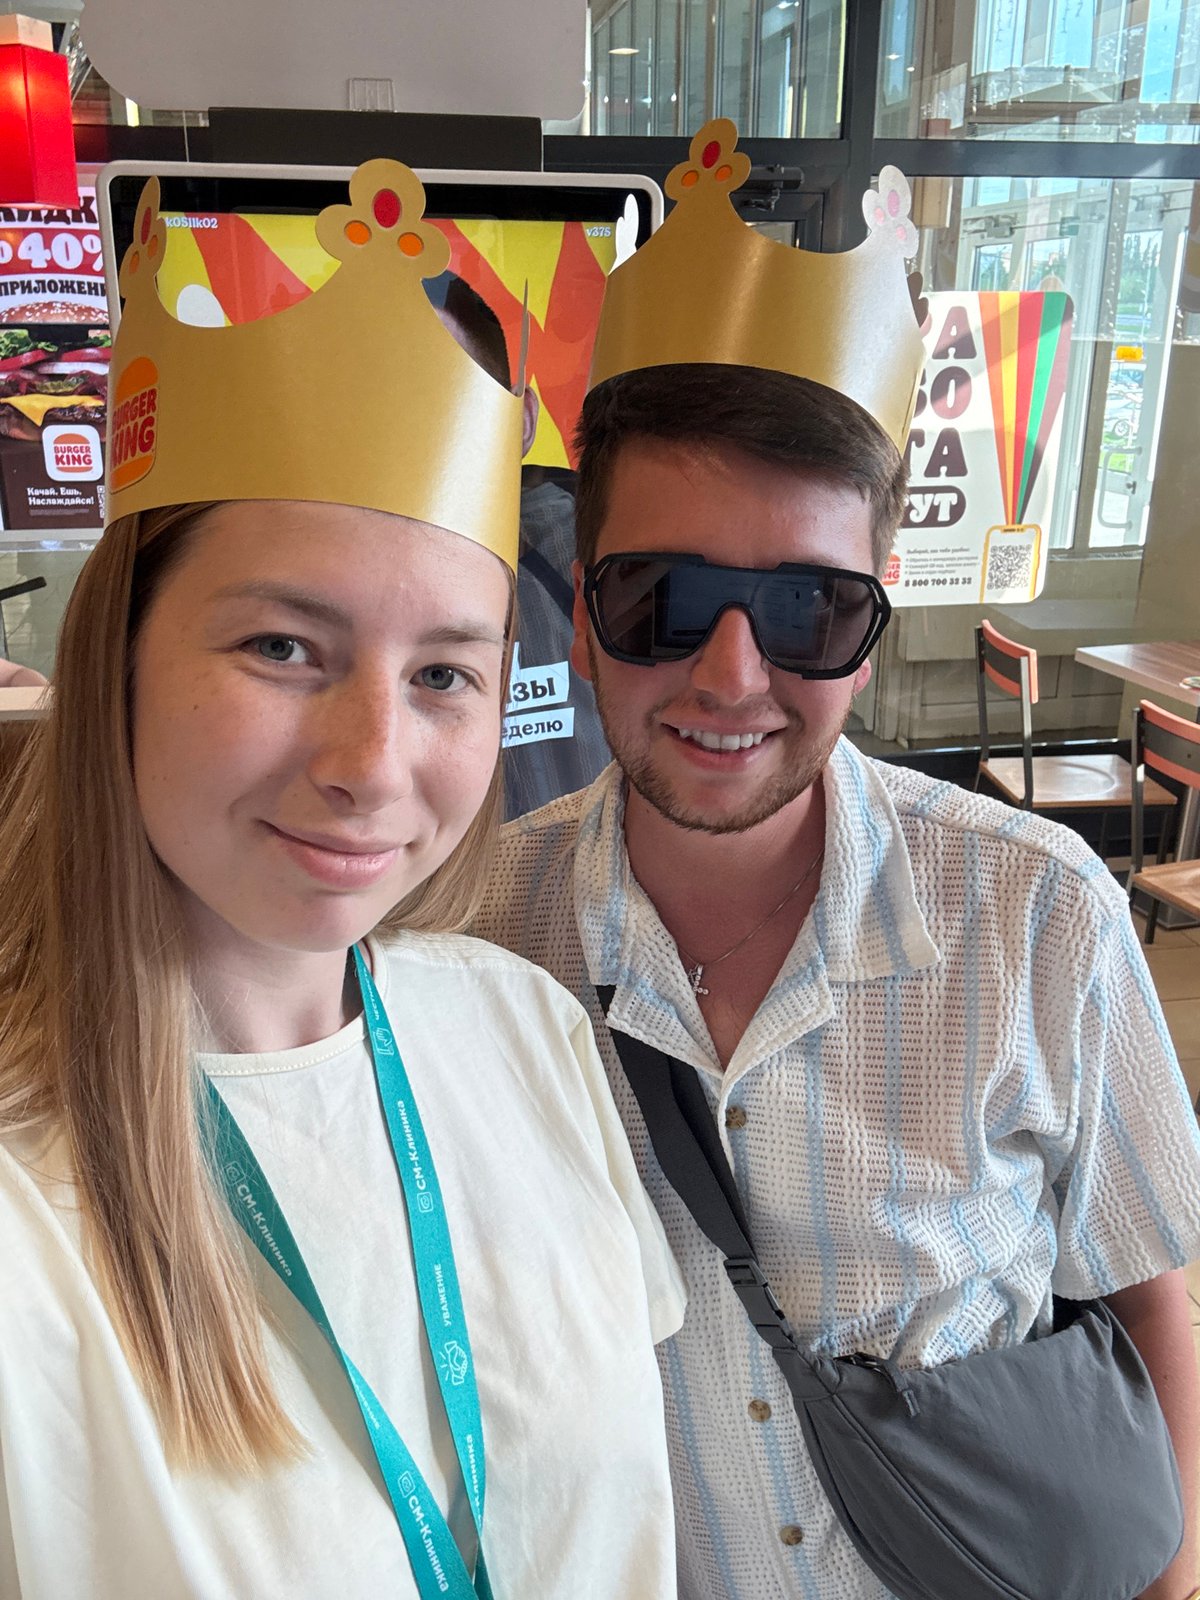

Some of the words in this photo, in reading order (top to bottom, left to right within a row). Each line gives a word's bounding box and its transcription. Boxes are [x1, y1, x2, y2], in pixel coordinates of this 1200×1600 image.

[54, 445, 92, 454] BURGER
[55, 454, 93, 466] KING
[397, 1100, 427, 1190] СМ-Клиника
[236, 1184, 293, 1277] СМ-Клиника
[434, 1263, 452, 1327] УВАЖЕНИЕ
[408, 1495, 449, 1592] СМ-Клиника
